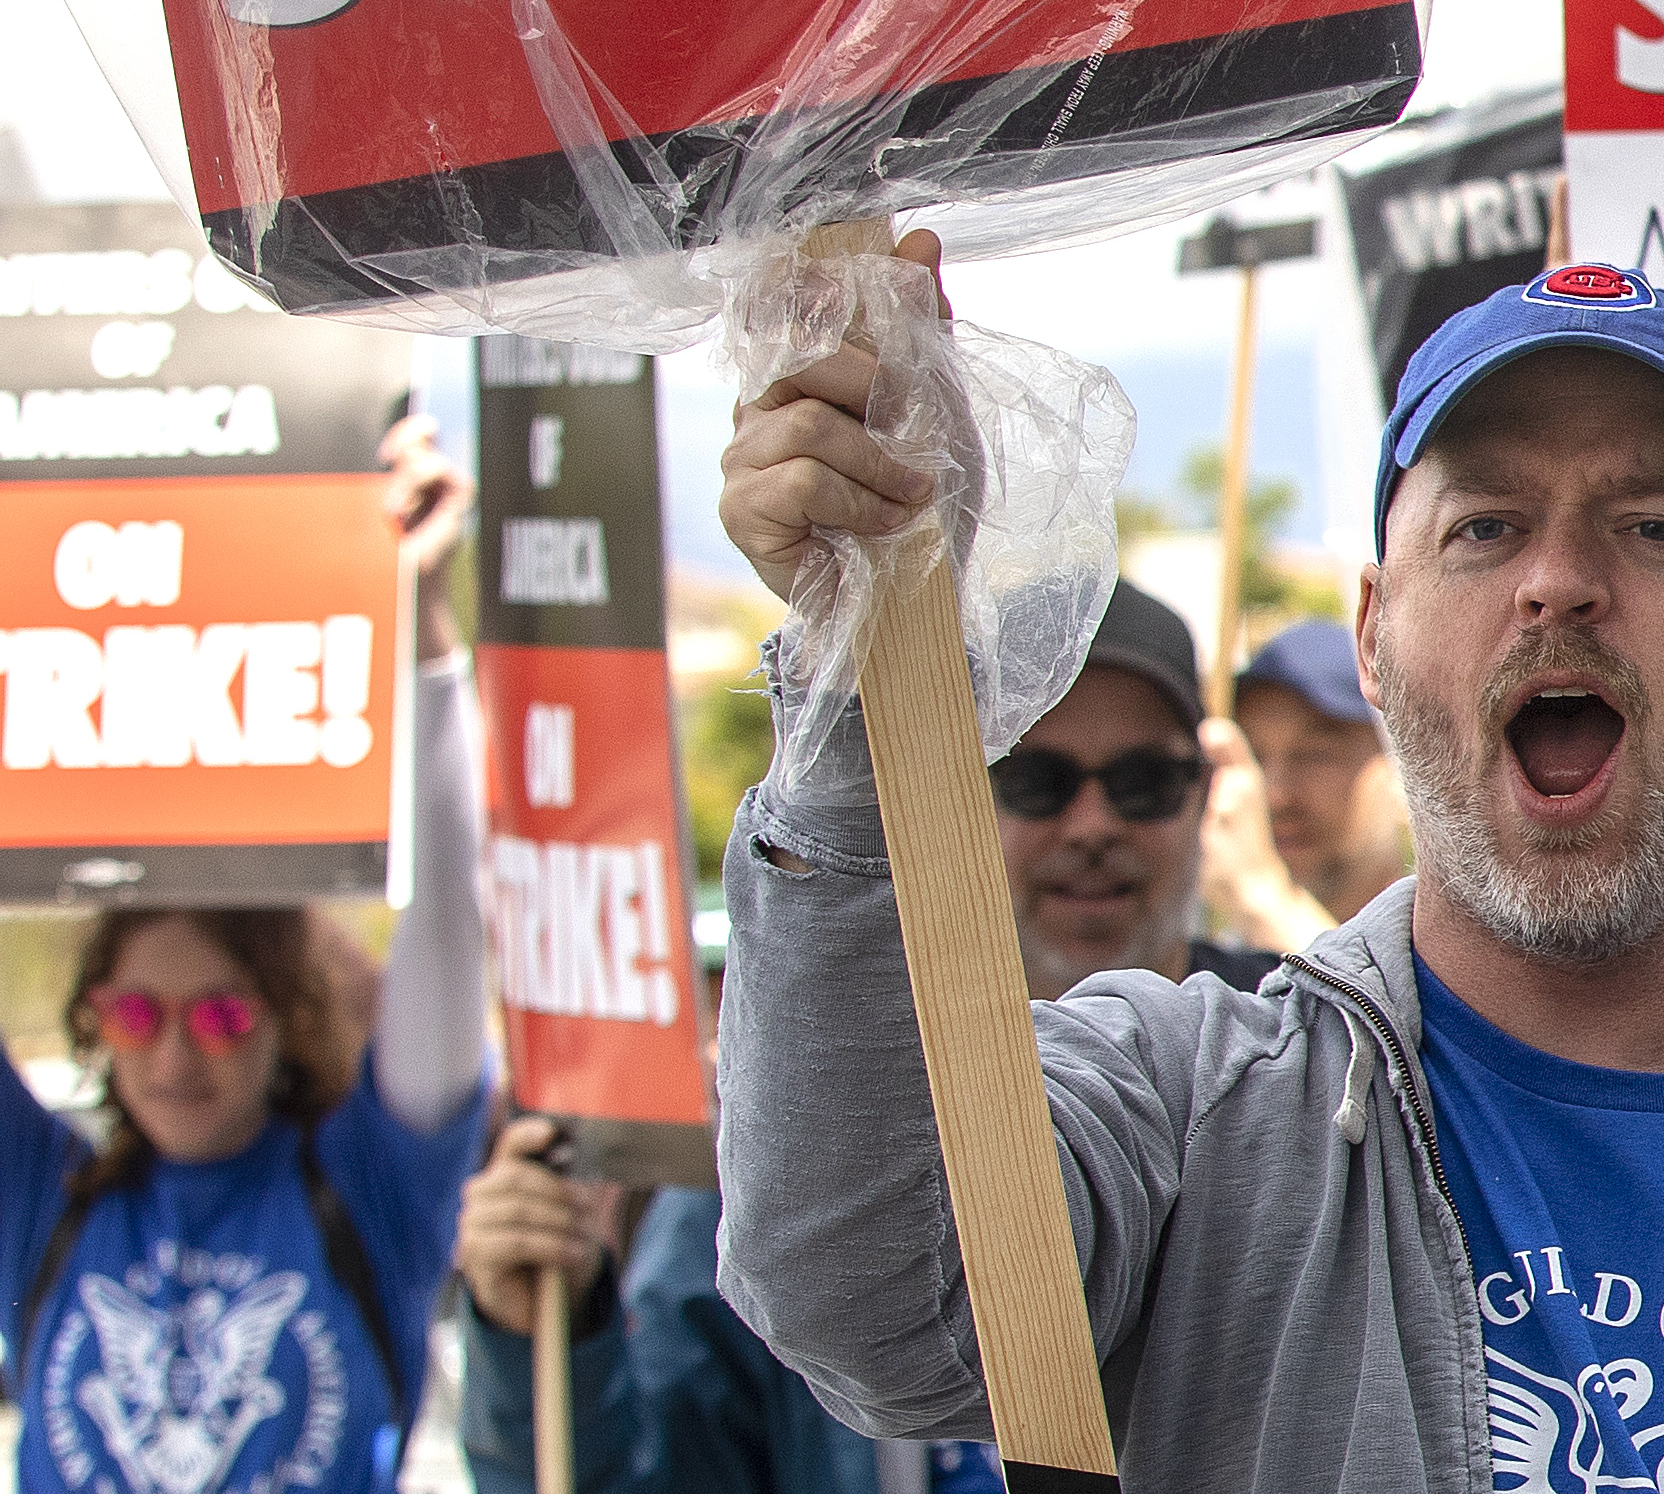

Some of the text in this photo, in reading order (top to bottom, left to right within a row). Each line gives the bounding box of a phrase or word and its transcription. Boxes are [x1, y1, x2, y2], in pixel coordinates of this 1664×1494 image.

[1075, 66, 1095, 89] AWAY
[1063, 86, 1084, 110] FROM
[1049, 107, 1073, 135] SMALL
[53, 520, 183, 609] ON
[495, 841, 679, 1029] TRIKE!
